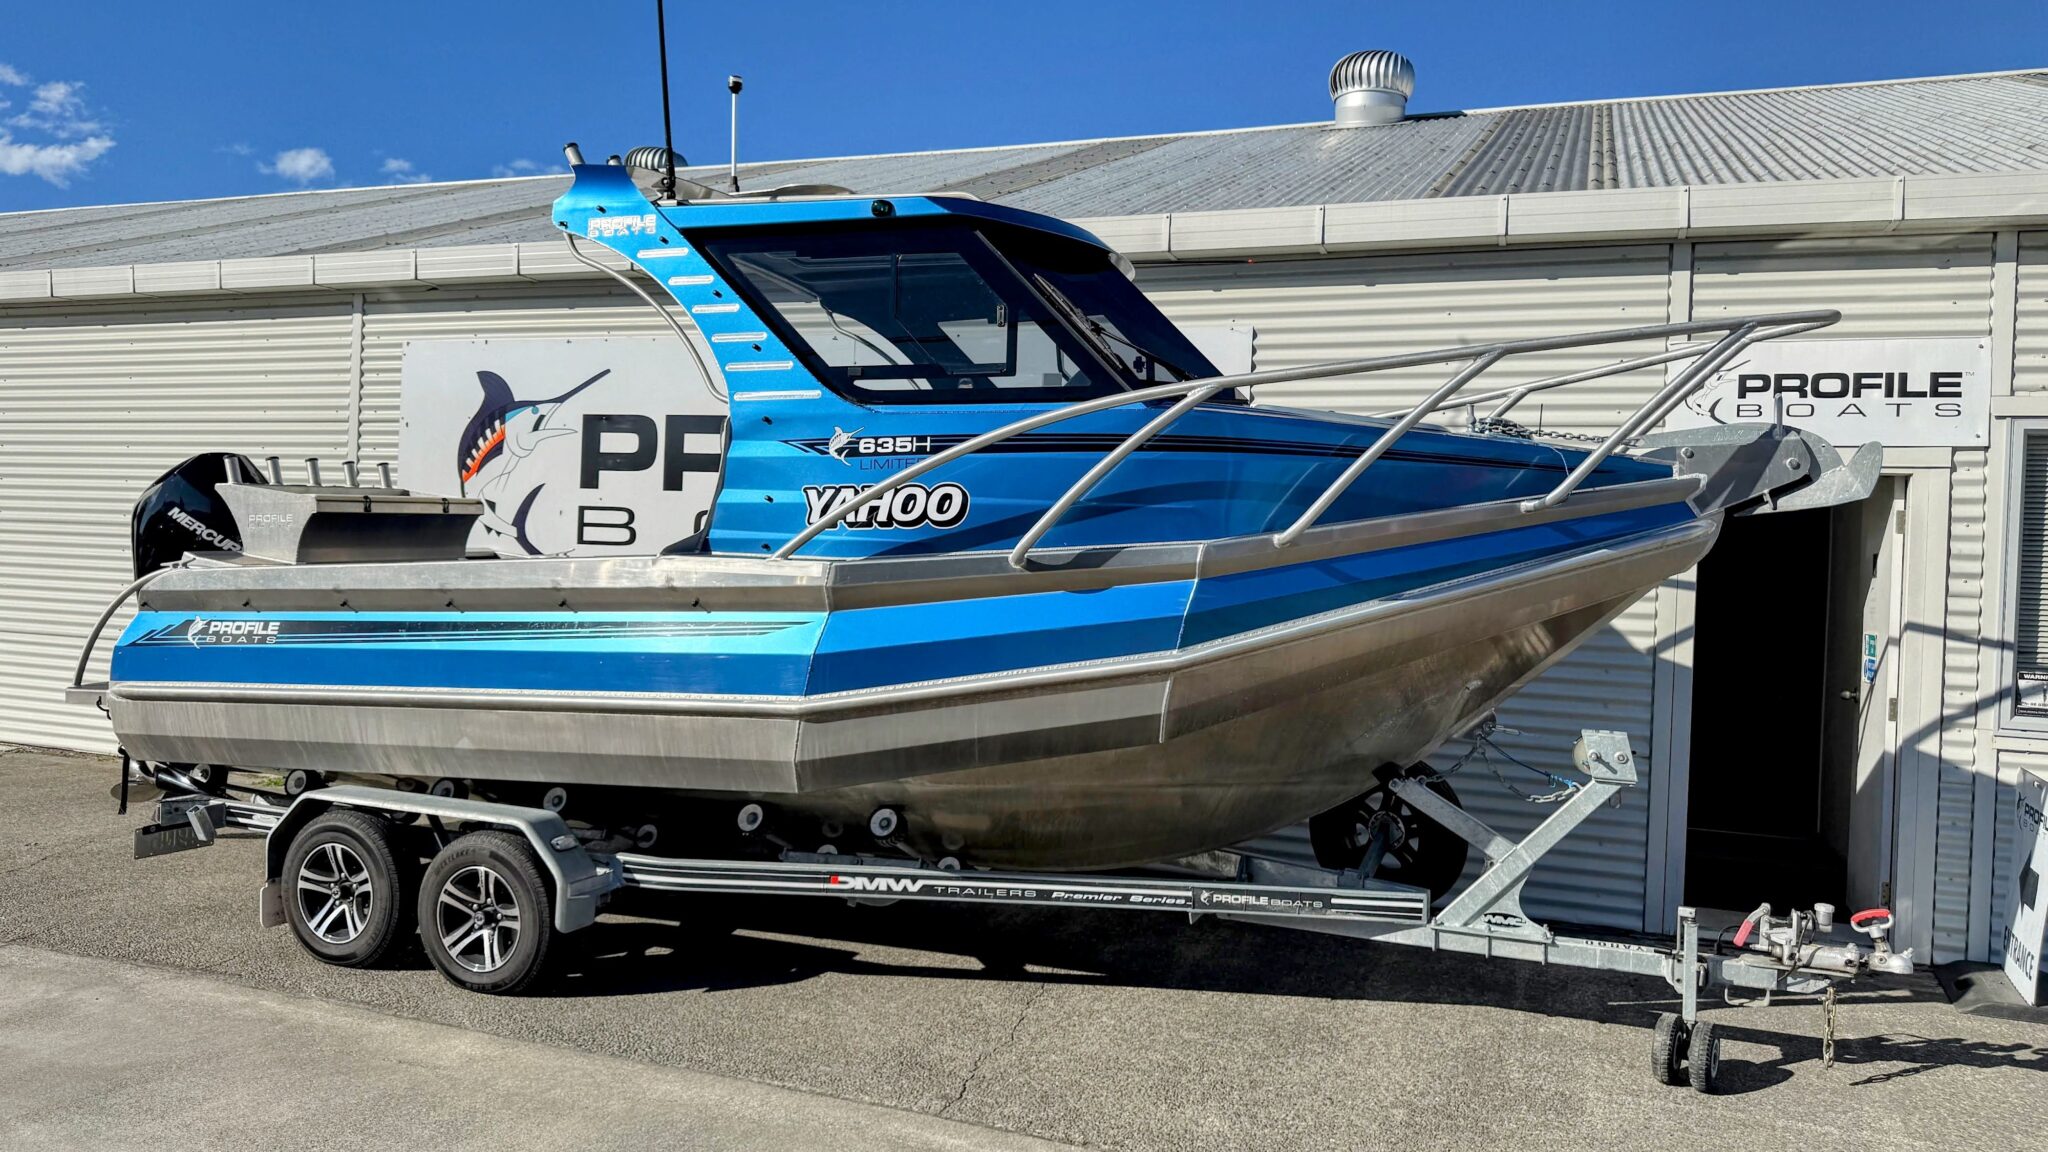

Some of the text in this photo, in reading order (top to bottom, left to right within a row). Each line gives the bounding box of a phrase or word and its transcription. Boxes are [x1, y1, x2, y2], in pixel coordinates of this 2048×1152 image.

[1737, 372, 1963, 399] PROFILE
[1736, 403, 1962, 418] BOATS
[859, 436, 931, 453] 635H
[860, 457, 928, 470] LIMITE
[803, 484, 969, 528] YAHOO
[248, 514, 293, 522] PROFILE
[167, 506, 242, 551] MERCUR
[208, 621, 280, 635] PROFILE
[206, 635, 277, 644] BOATS
[830, 875, 925, 892] DMW
[934, 886, 1037, 898] TRAILERS
[1051, 891, 1122, 901] Premier
[1212, 894, 1323, 908] PROFILE BOATS
[2003, 924, 2034, 982] ENTRANCE
